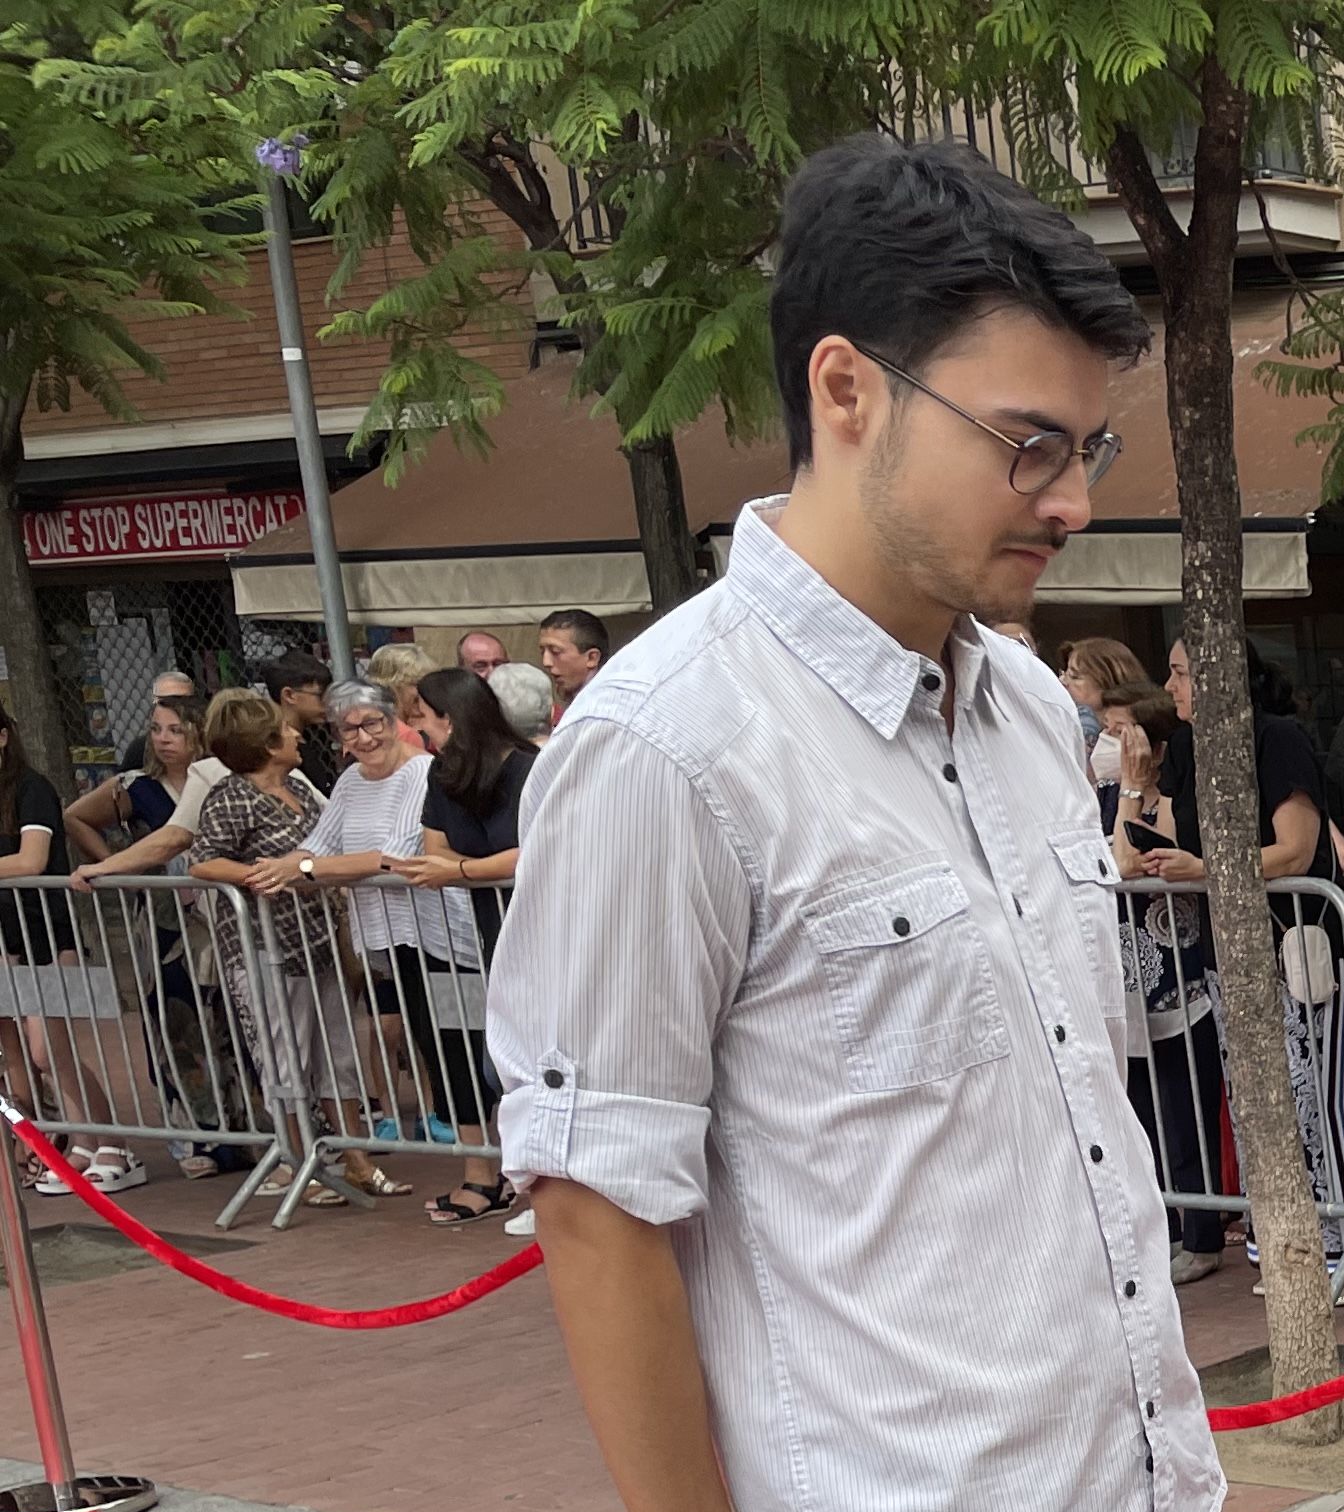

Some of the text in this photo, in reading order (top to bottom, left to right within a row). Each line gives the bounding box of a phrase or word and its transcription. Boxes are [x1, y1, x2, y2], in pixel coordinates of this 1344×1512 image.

[35, 494, 288, 556] ONE STOP SUPERMERCAT
